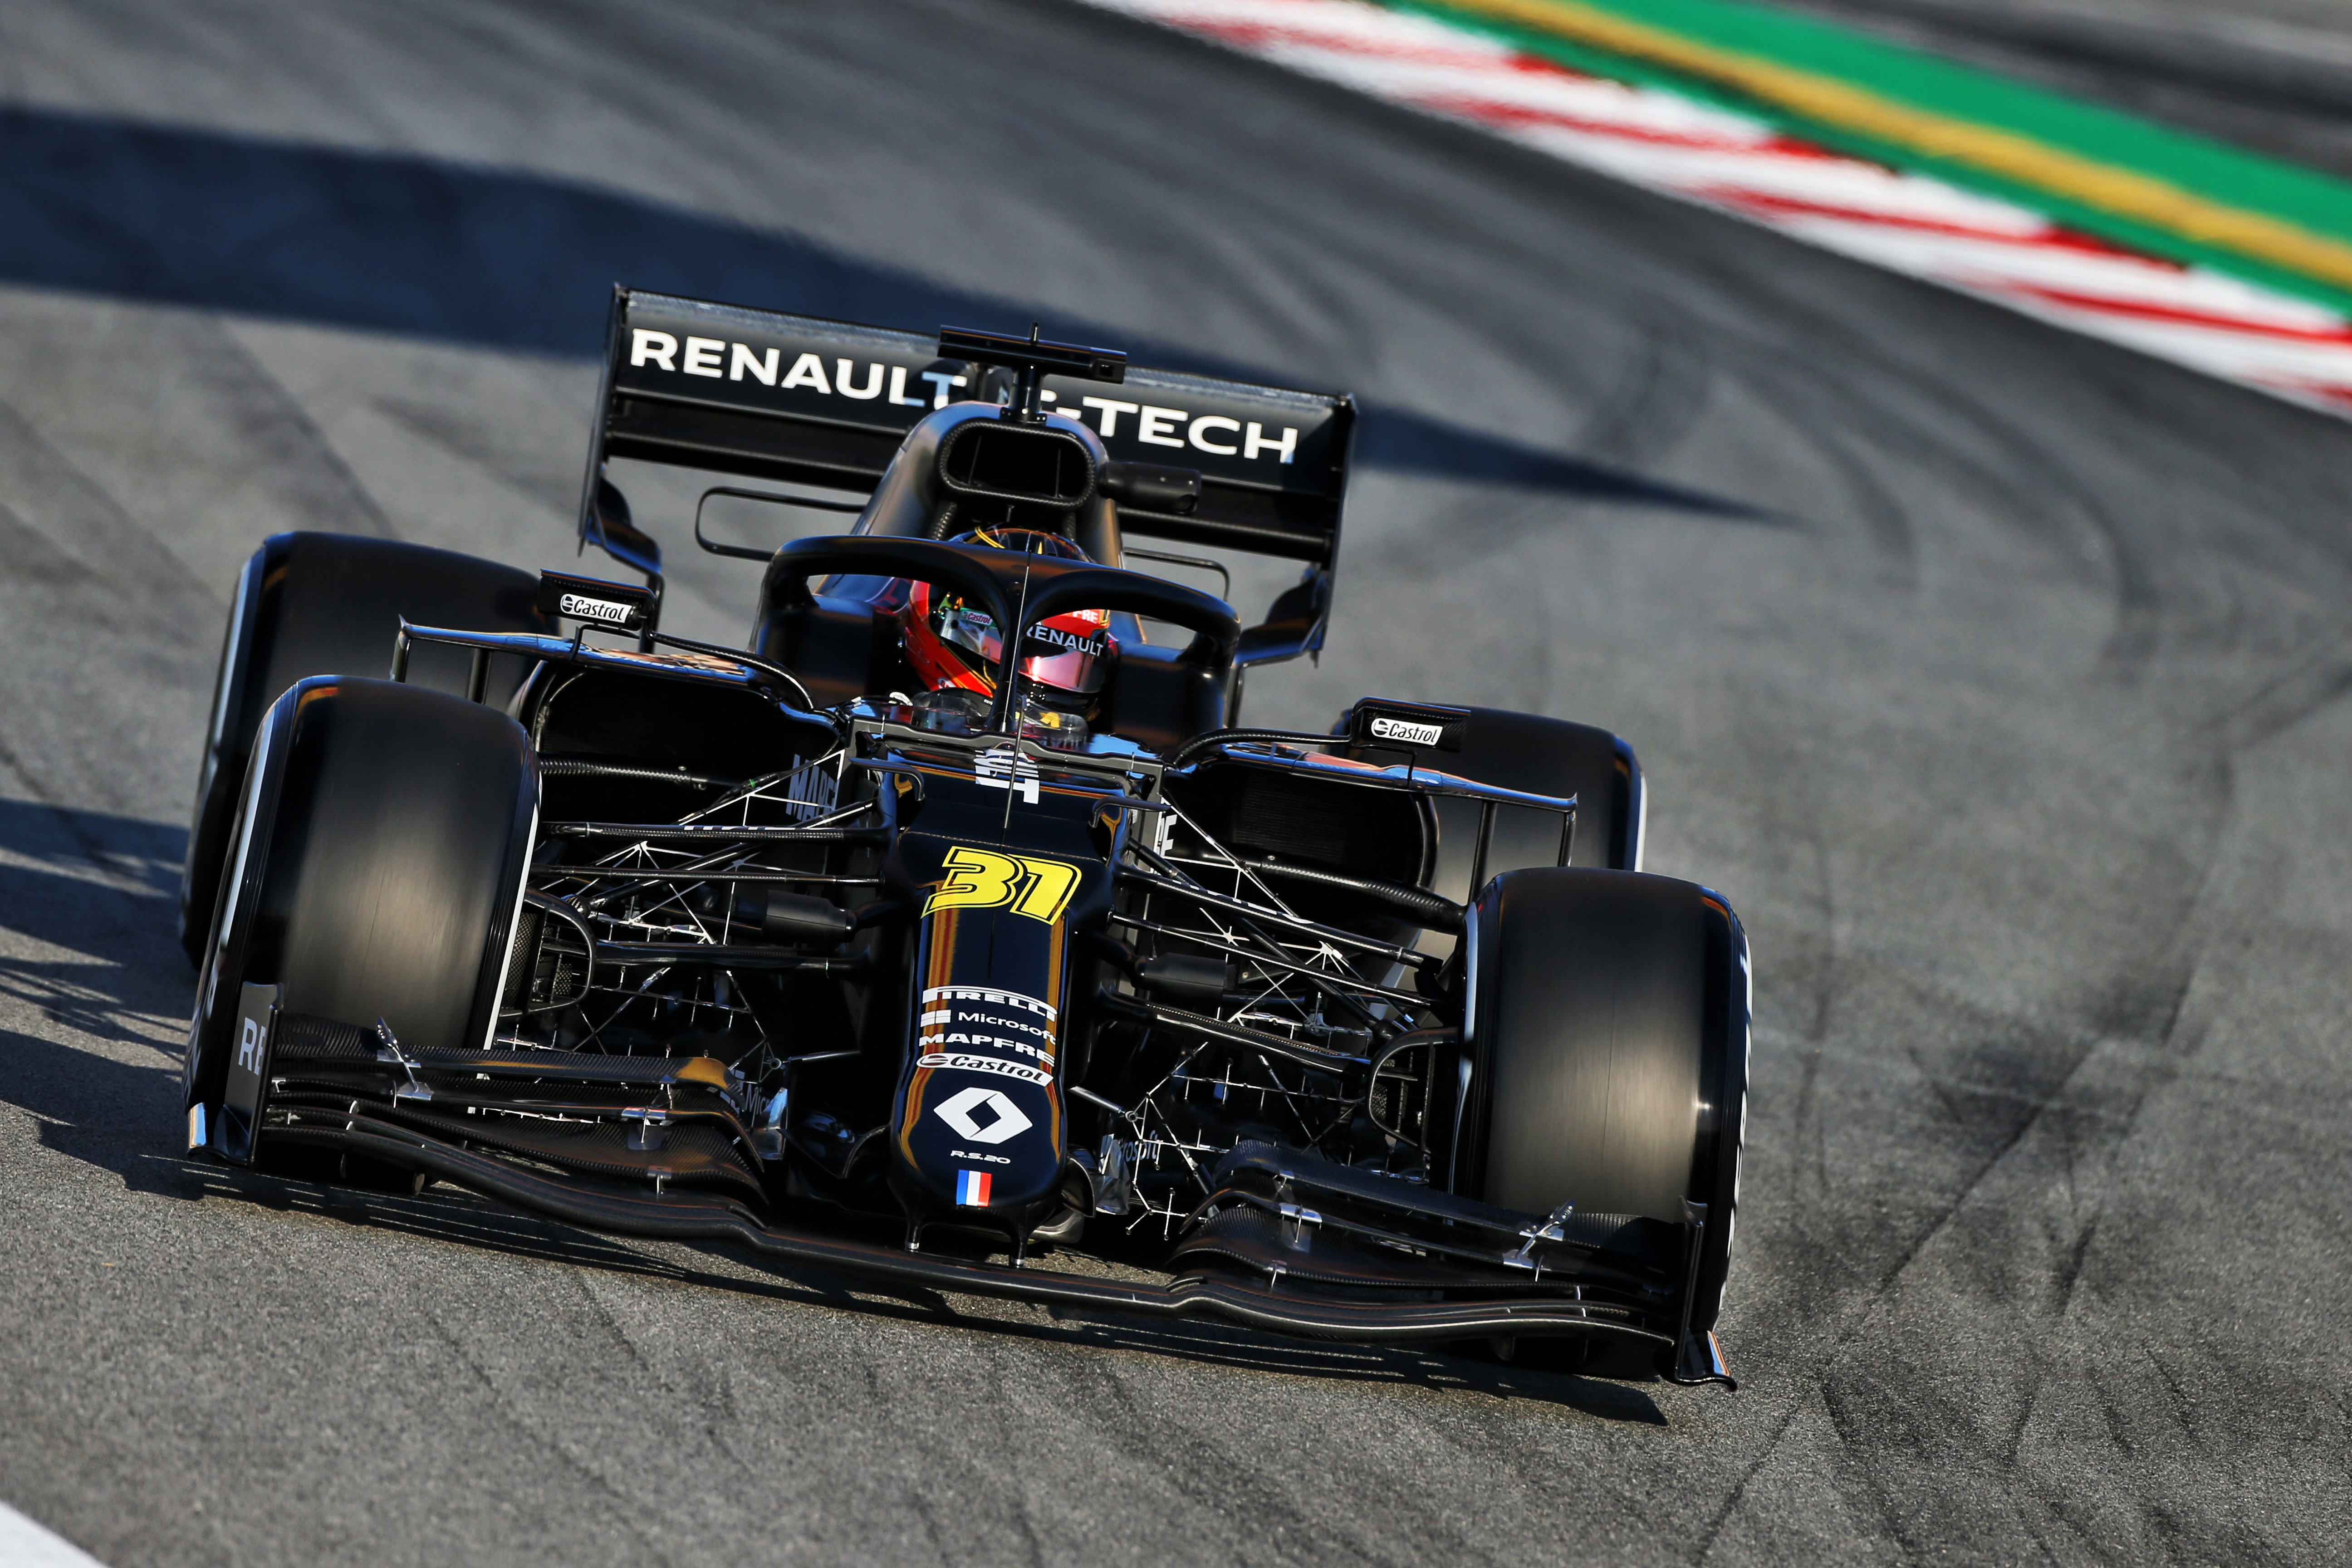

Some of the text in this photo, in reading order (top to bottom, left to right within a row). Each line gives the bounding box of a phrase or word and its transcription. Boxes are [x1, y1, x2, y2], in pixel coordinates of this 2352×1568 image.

[631, 328, 1298, 464] RENAULT -TECH
[573, 600, 625, 620] Castrol
[967, 612, 991, 624] Castrol
[1389, 723, 1438, 742] Castrol
[921, 846, 1082, 926] 31
[922, 985, 1057, 1022] PIRELLI
[958, 1012, 1056, 1045] Microsoft
[919, 1033, 1055, 1067] MAPFRE
[950, 1056, 1043, 1082] Castrol
[951, 1150, 1011, 1164] R.S.20
